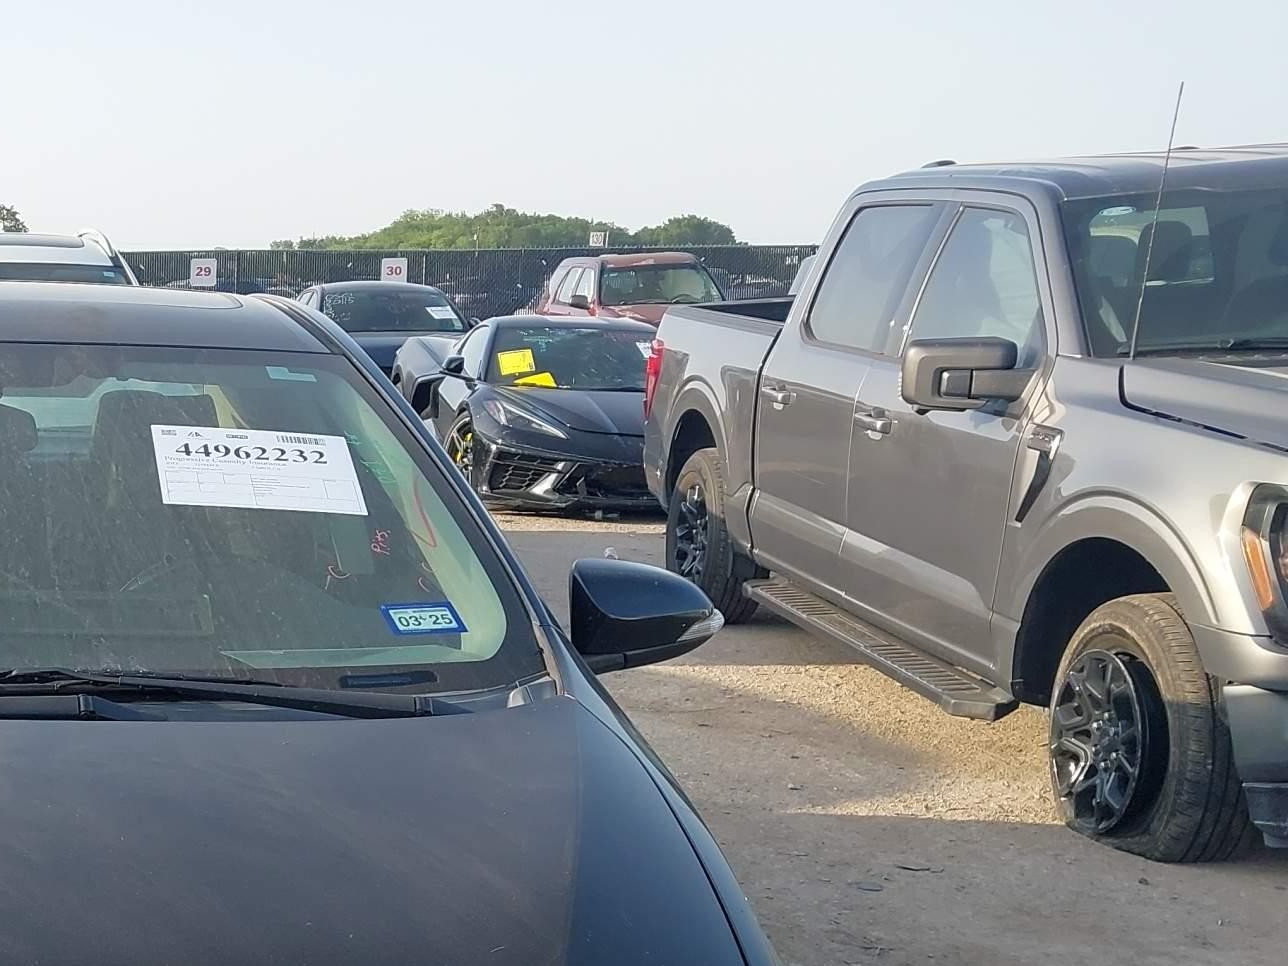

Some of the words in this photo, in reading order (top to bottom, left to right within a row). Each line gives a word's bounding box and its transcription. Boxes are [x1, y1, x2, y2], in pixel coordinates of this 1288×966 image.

[195, 266, 212, 277] 29
[386, 266, 402, 276] 30
[175, 442, 328, 465] 44962232
[398, 615, 422, 627] 03
[428, 613, 453, 625] 25
